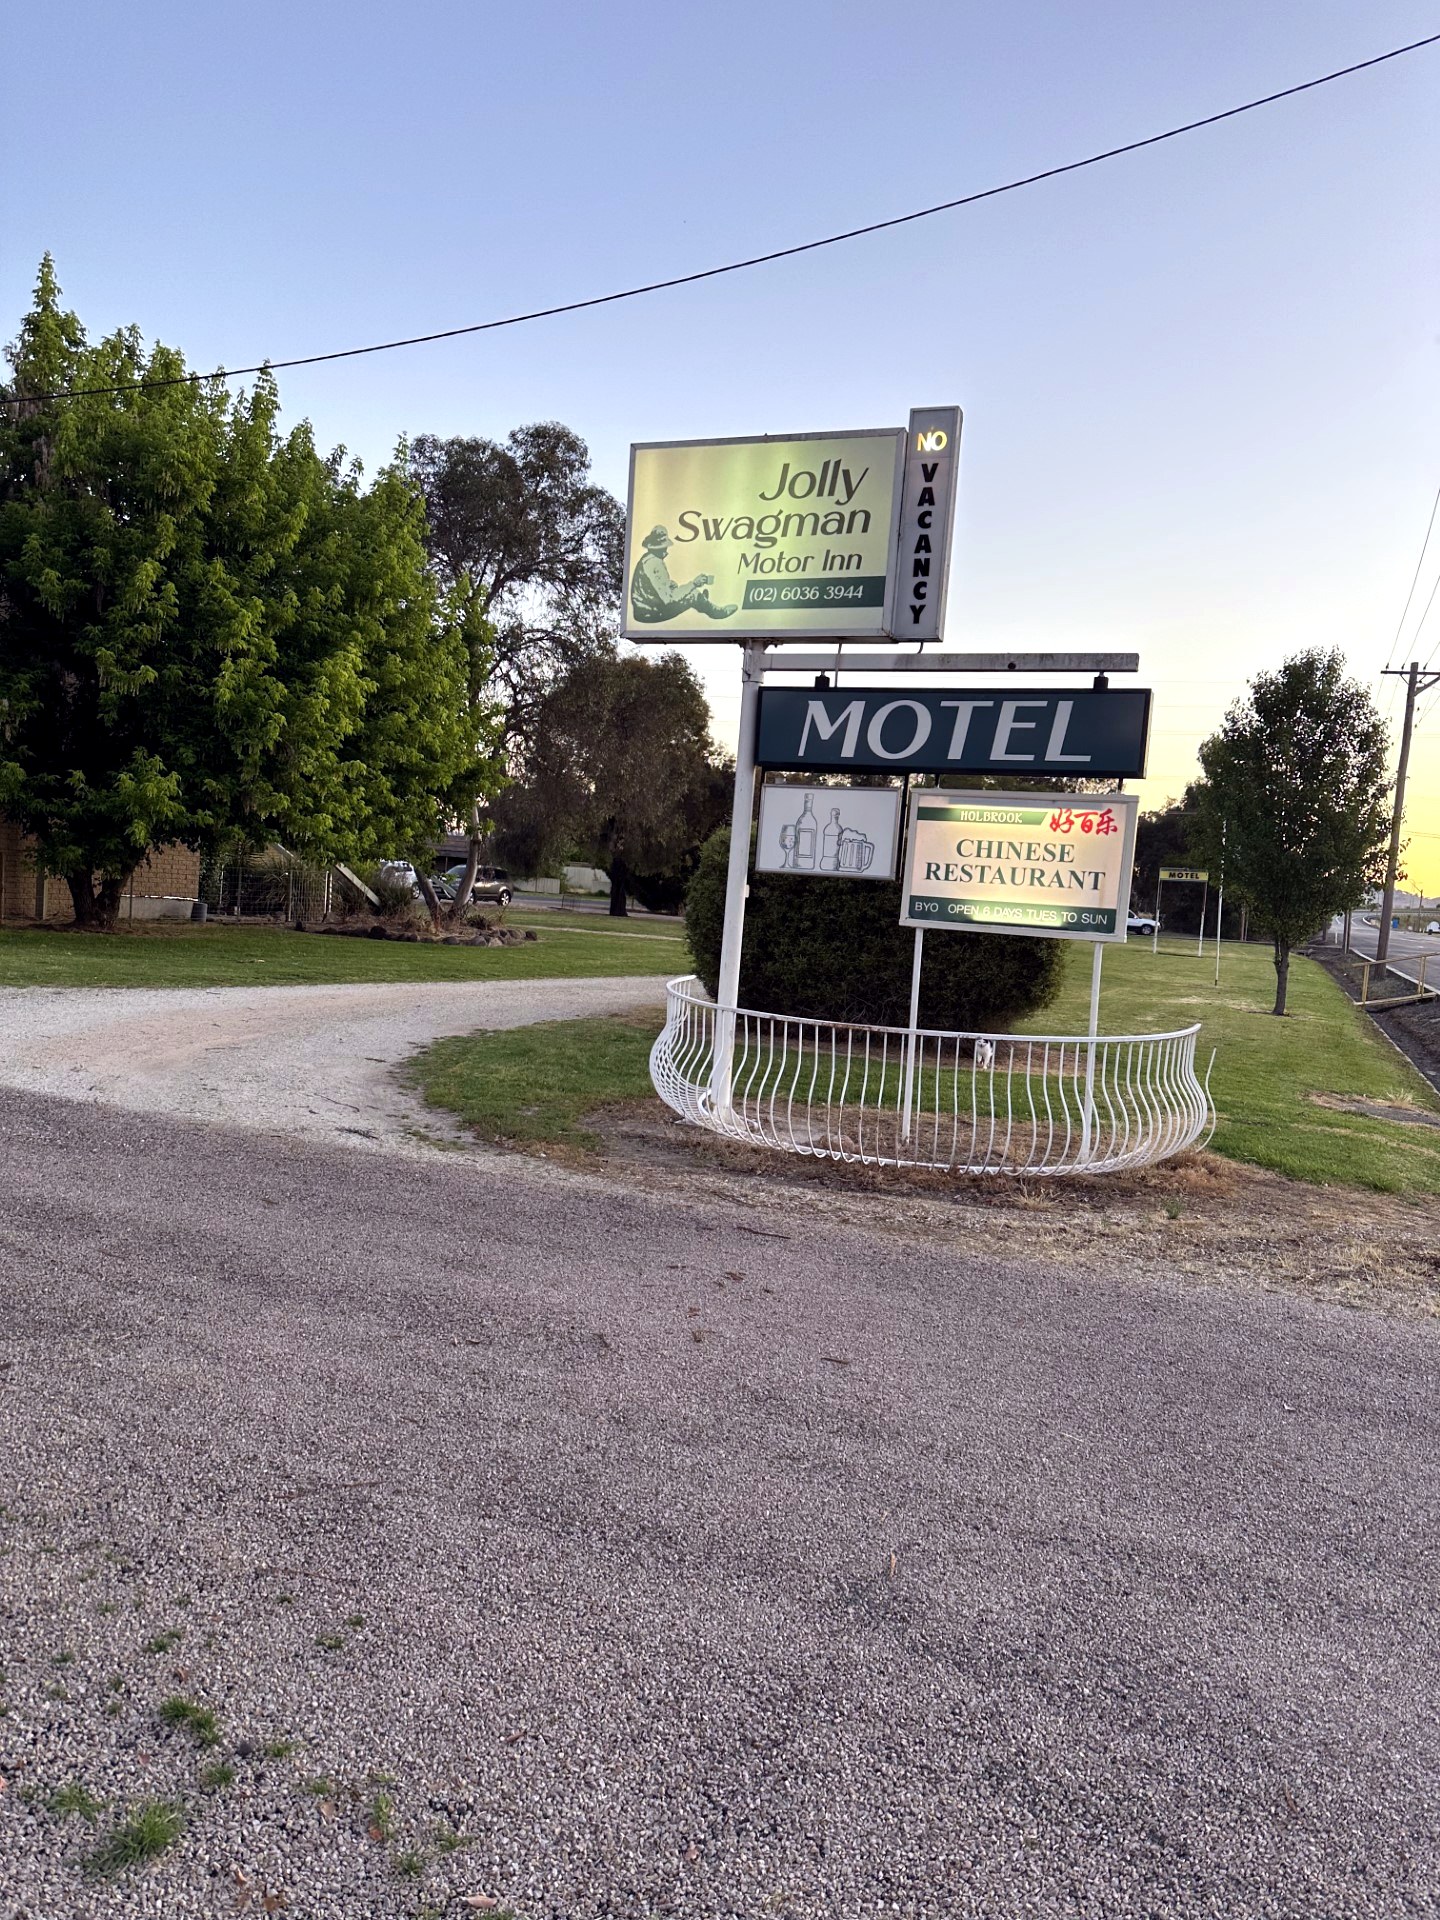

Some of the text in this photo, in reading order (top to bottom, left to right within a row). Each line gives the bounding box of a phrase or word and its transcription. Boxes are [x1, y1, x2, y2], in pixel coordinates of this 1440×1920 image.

[917, 431, 947, 451] NO
[759, 459, 869, 505] Jolly
[674, 509, 871, 548] Swagman
[910, 463, 939, 624] VACANCY
[737, 549, 862, 574] Motor Inn
[749, 585, 863, 602] (02) 6036 3944
[798, 700, 1092, 762] MOTEL
[960, 810, 1023, 824] HOLBROOK
[1050, 808, 1118, 836] 好百乐
[956, 838, 1075, 863] CHINESE
[924, 862, 1106, 891] RESTAURANT
[1168, 871, 1200, 880] MOTEL
[915, 901, 1108, 926] BYO OPEN 6 DAYS TUES TO SUN
